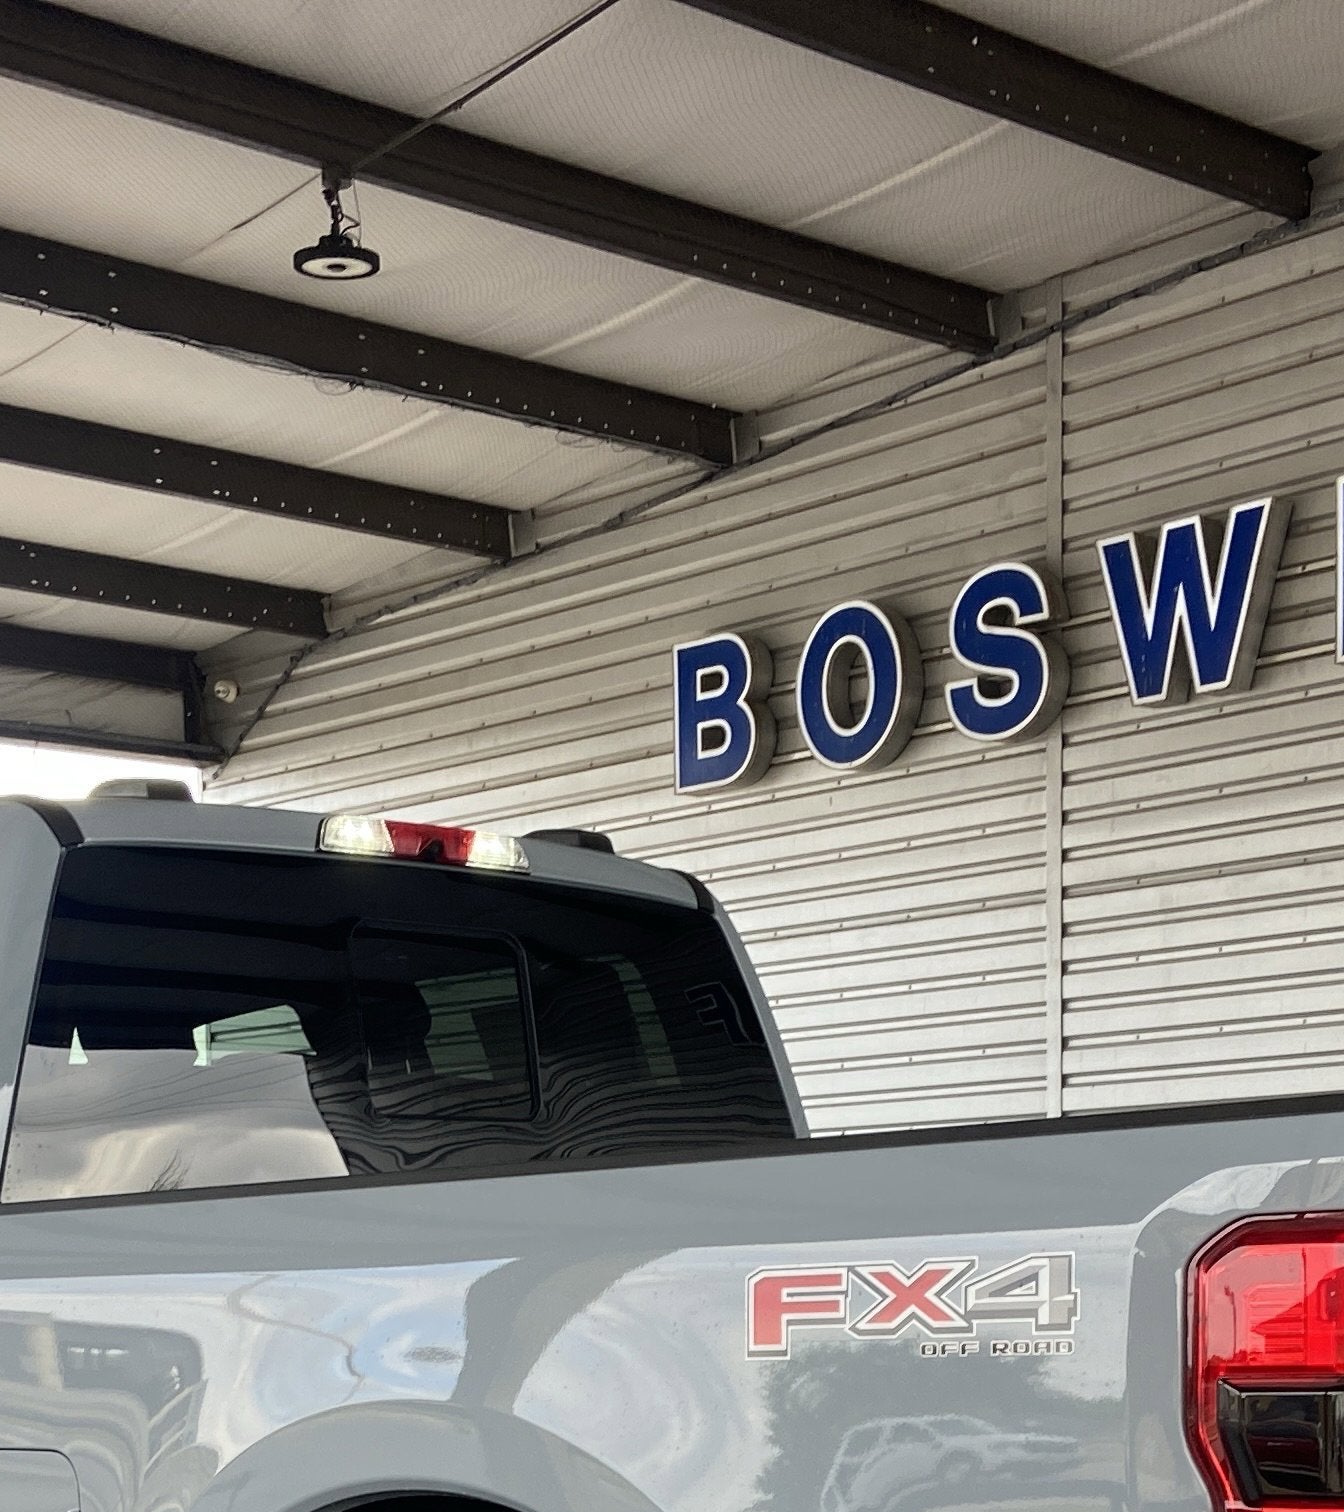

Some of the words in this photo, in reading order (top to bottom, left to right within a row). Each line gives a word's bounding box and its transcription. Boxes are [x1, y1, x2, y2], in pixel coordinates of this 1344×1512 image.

[745, 1251, 1080, 1360] FX4
[920, 1340, 980, 1357] OFF
[992, 1339, 1074, 1356] ROAD
